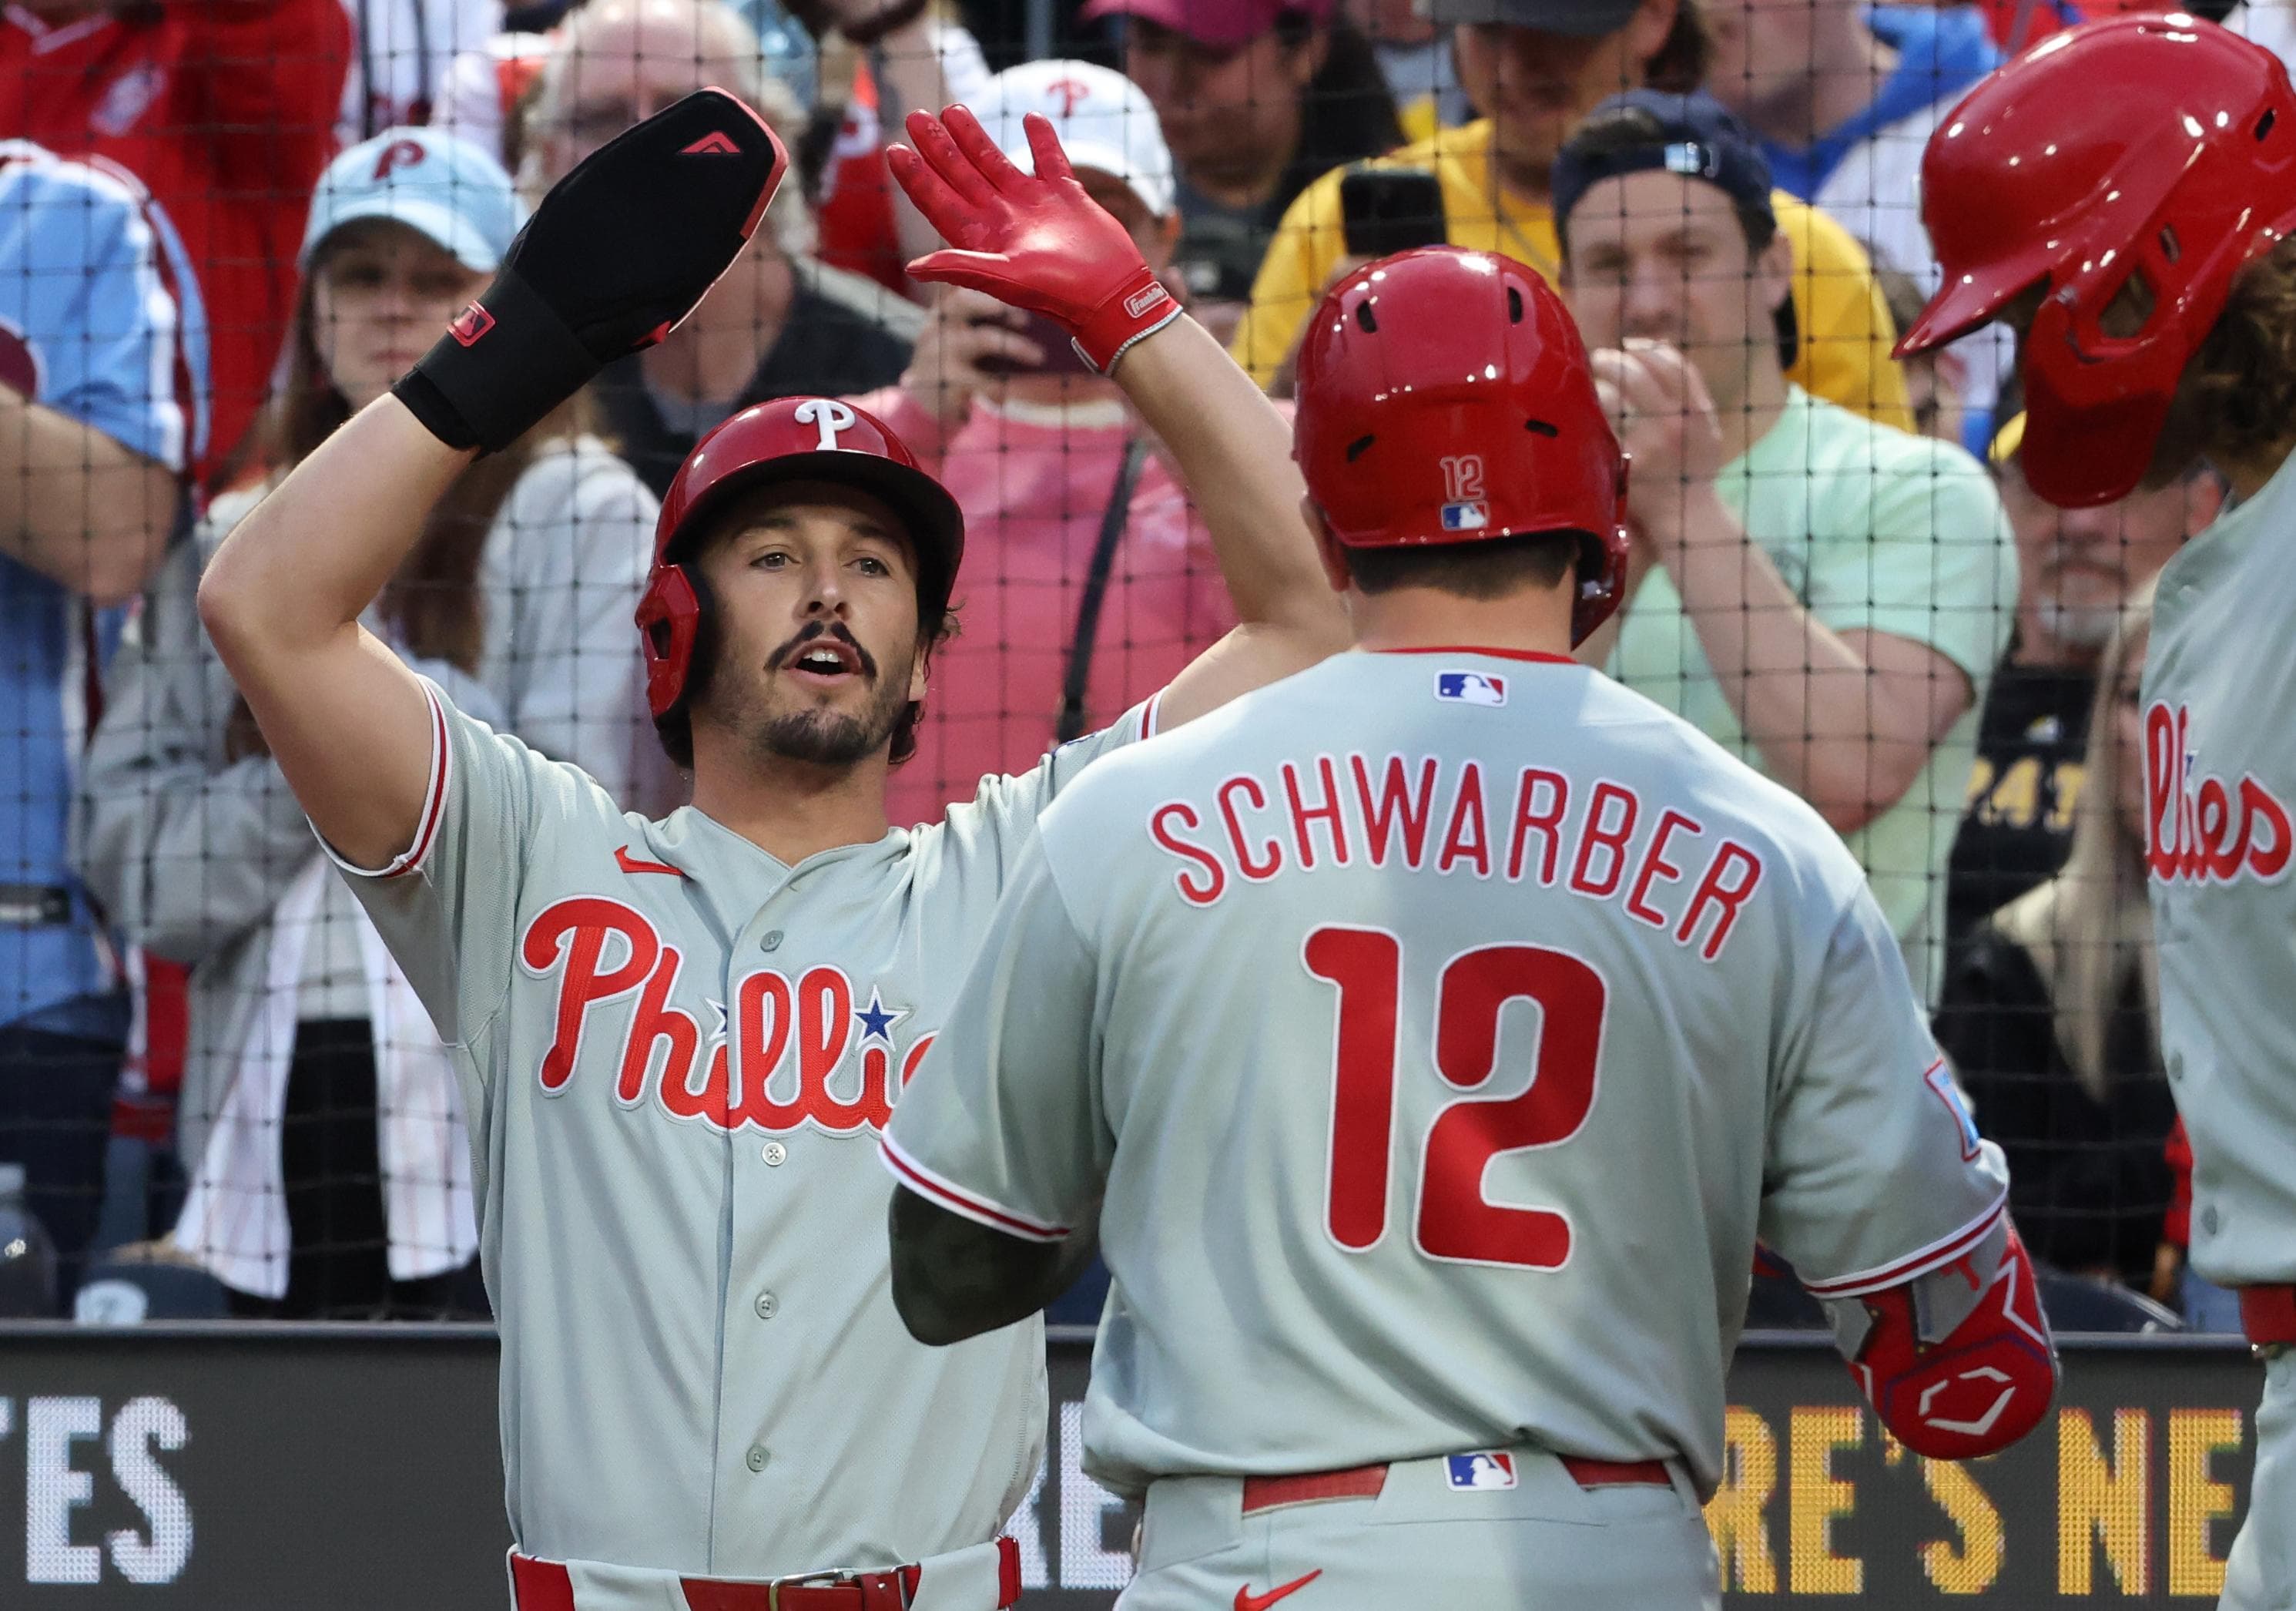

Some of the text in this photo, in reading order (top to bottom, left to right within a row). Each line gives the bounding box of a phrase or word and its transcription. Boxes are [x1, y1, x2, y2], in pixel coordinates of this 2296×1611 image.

[794, 398, 855, 451] P
[1440, 455, 1485, 502] 12
[1148, 750, 1765, 964] SCHWARBER
[520, 894, 941, 1137] Philli
[1300, 921, 1609, 1271] 12
[0, 1395, 194, 1585] ES
